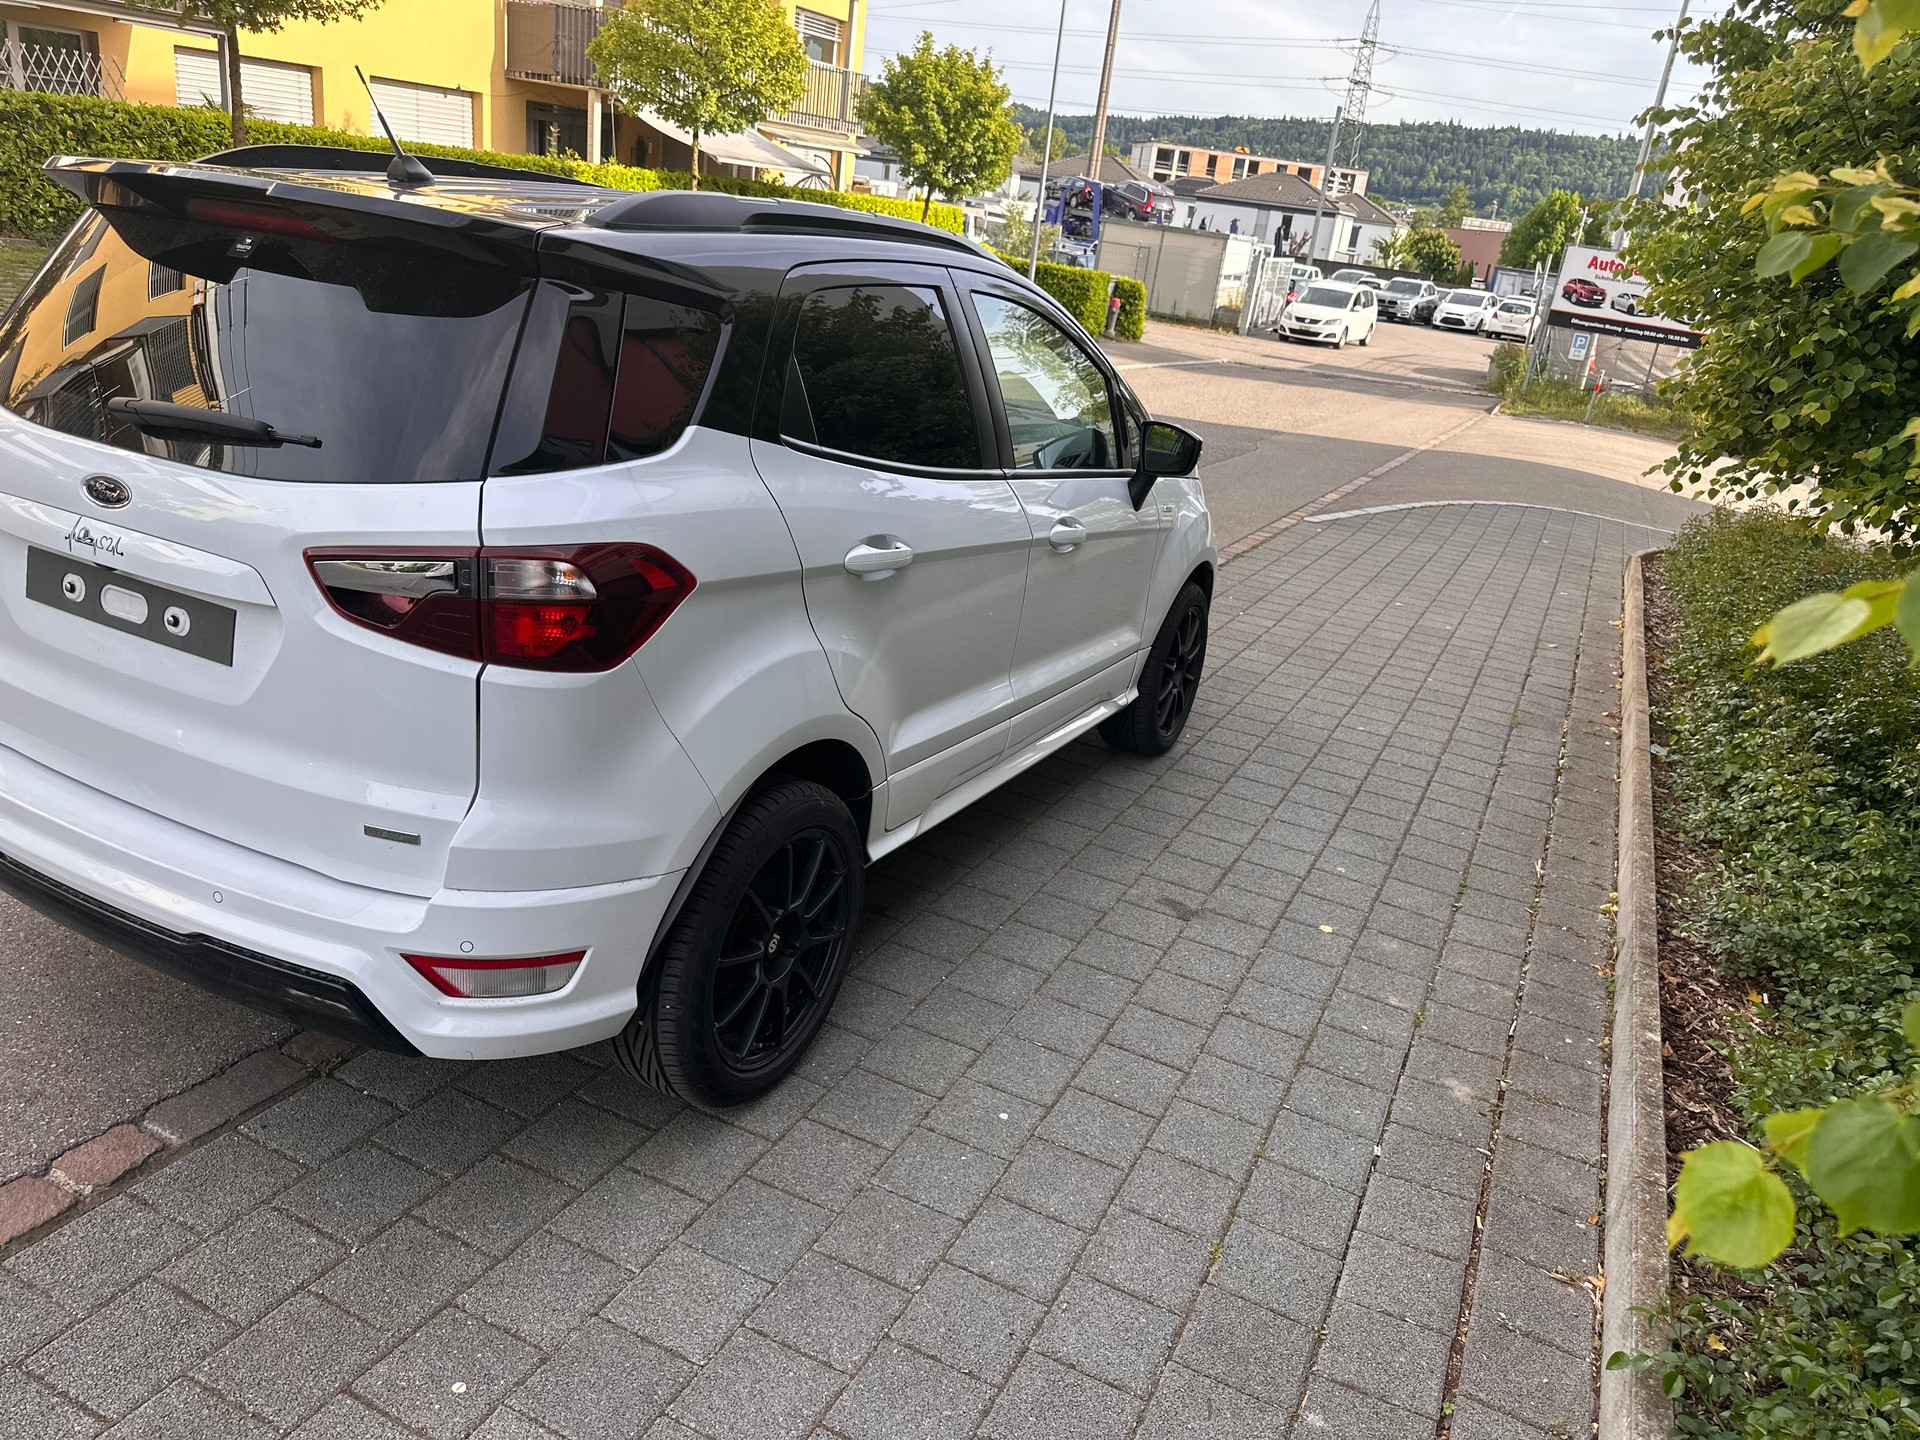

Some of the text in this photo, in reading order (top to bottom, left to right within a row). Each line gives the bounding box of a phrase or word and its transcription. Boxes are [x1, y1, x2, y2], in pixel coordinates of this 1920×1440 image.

[1605, 324, 1622, 332] Montag
[1625, 327, 1643, 336] Samstag
[1575, 336, 1586, 347] P
[92, 480, 121, 499] Ford
